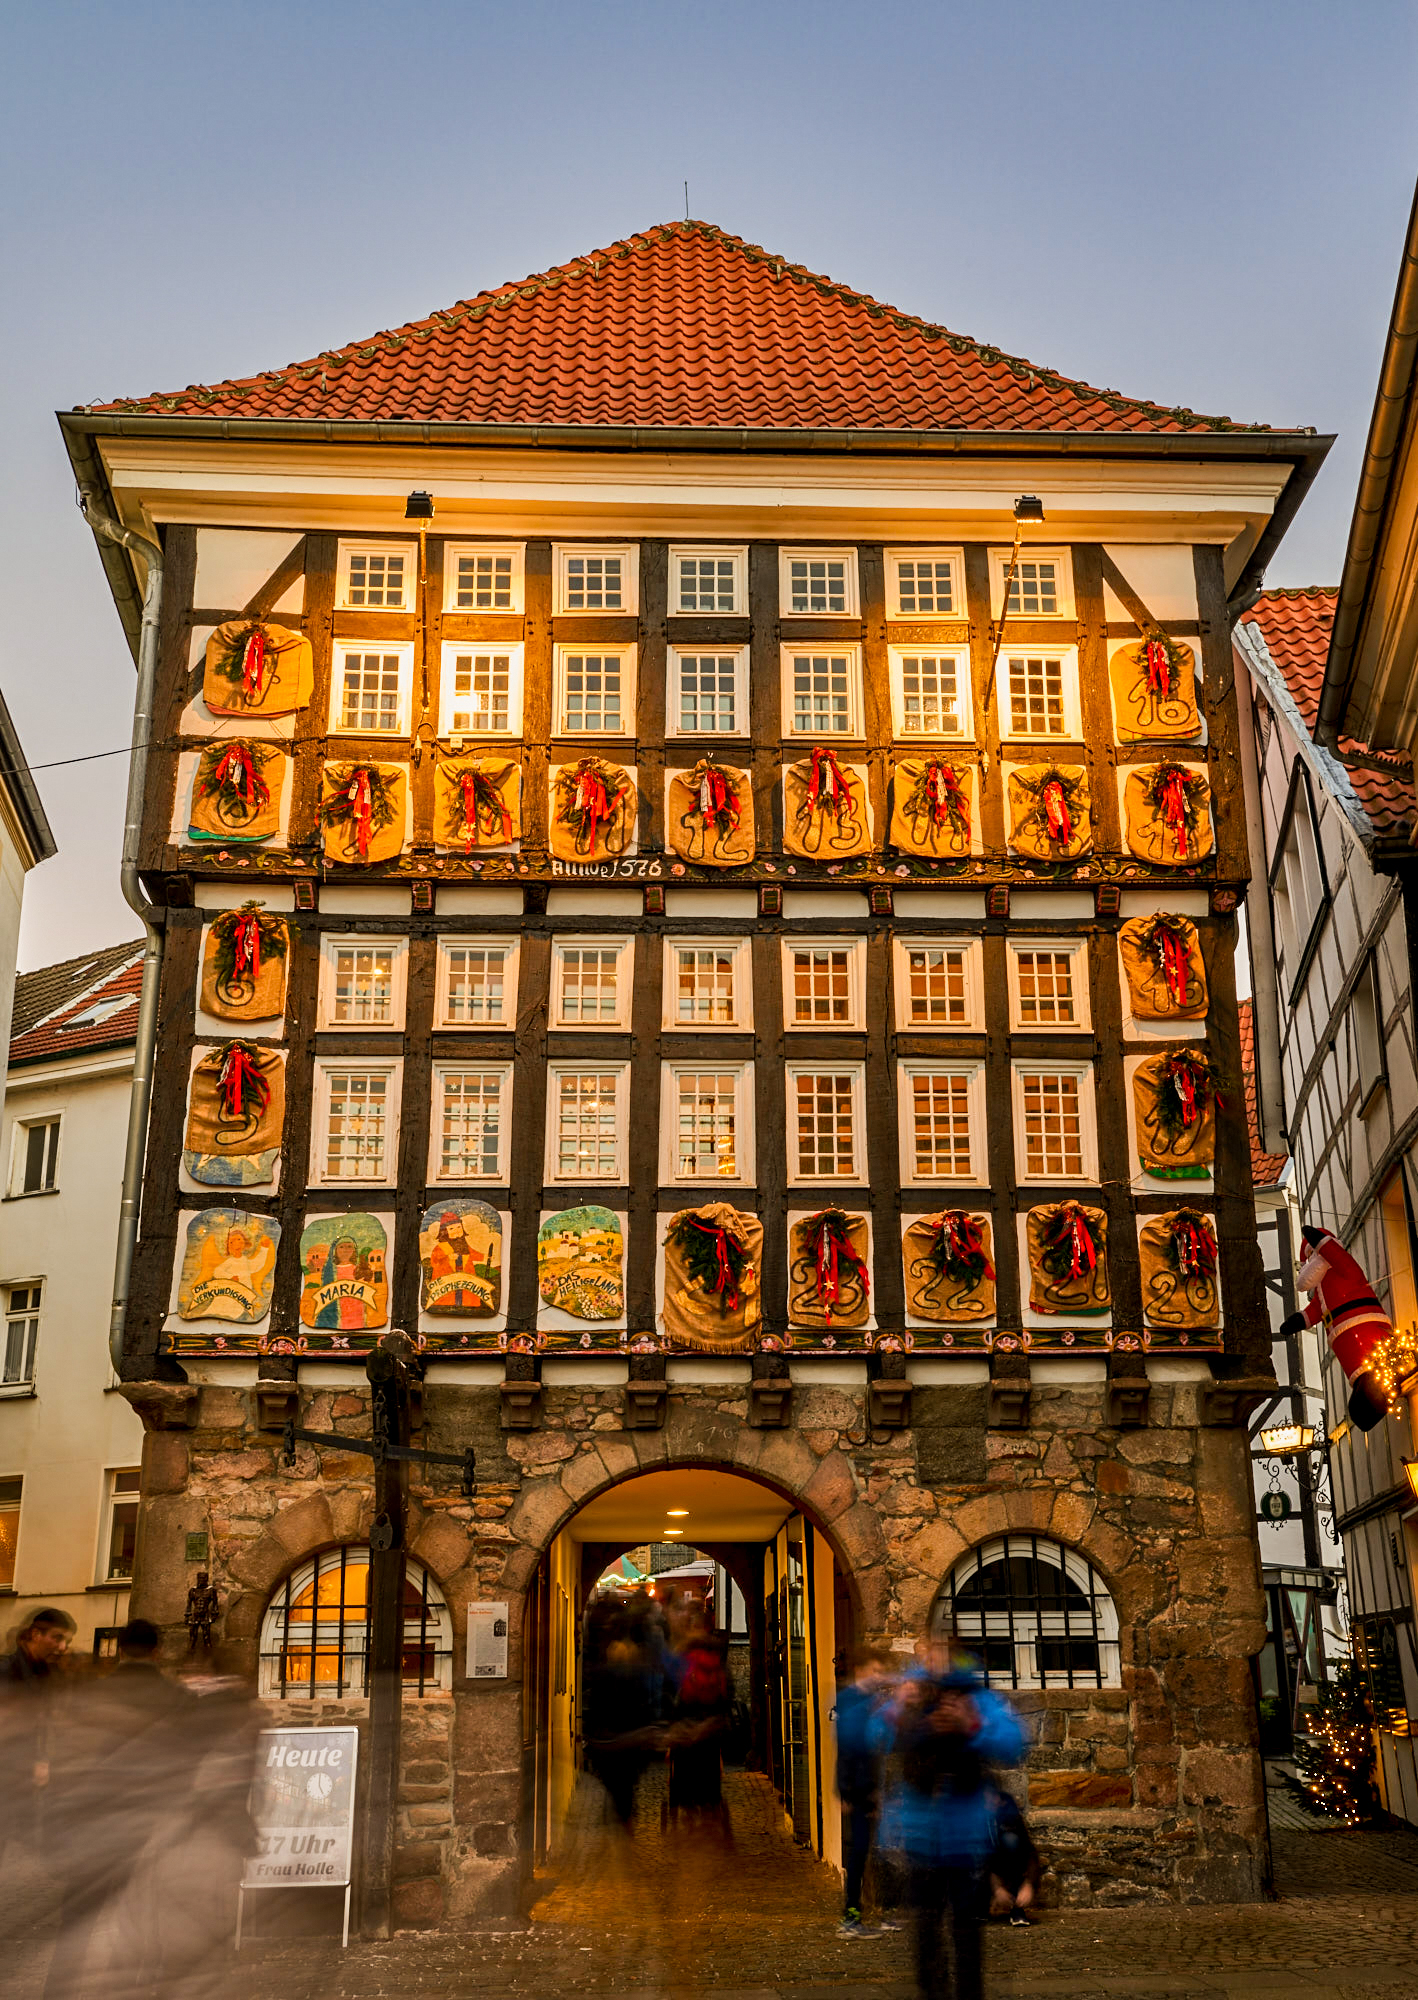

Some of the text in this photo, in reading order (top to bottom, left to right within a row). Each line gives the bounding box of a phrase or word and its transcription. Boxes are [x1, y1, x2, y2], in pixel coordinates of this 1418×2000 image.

[1128, 678, 1191, 726] 16
[796, 795, 862, 853] 13
[215, 1098, 259, 1145] 5
[194, 1281, 208, 1294] DIE
[428, 1276, 443, 1290] DIE
[557, 1271, 581, 1287] DAS
[559, 1275, 618, 1298] HEILIGE LAND
[791, 1256, 865, 1318] 23
[194, 1285, 253, 1310] VERKÜNDIGUNG
[320, 1283, 365, 1304] MARIA
[429, 1280, 490, 1302] PROPHEZEIUNG
[1144, 1270, 1216, 1324] 20
[266, 1746, 343, 1768] Heute
[259, 1834, 336, 1855] 17 Uhr
[256, 1862, 334, 1876] Frau Holle
